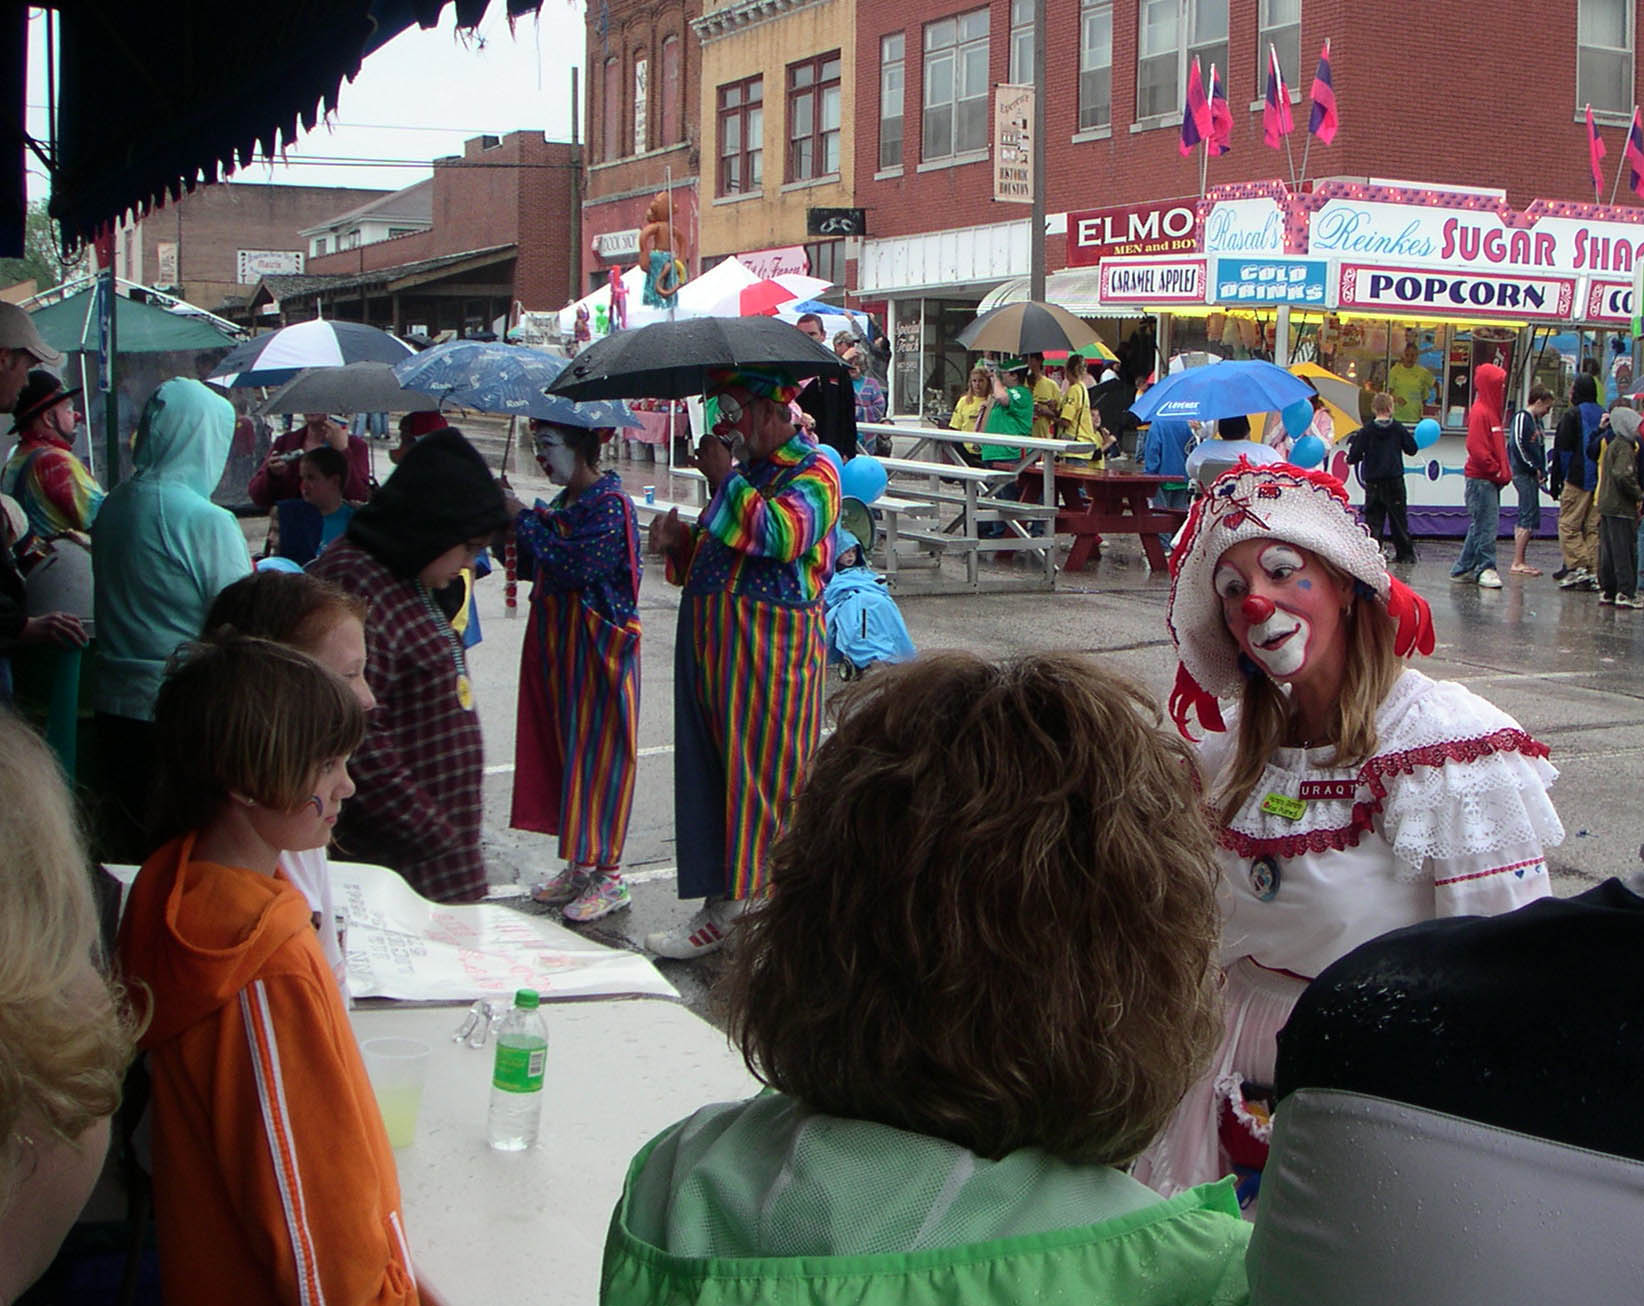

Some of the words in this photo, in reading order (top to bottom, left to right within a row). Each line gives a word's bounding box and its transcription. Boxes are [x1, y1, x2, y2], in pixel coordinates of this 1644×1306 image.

[1078, 207, 1194, 247] ELMO
[1207, 208, 1279, 252] Rascal's
[1313, 207, 1436, 257] Reinkes
[1441, 217, 1556, 267] SUGAR
[1114, 243, 1142, 255] MEN
[1145, 241, 1169, 252] and
[1111, 269, 1155, 293] CARAMEL
[1159, 268, 1196, 293] APPLES
[1241, 264, 1307, 283] COLD
[1219, 281, 1323, 300] DRINKS
[1369, 274, 1545, 309] POPCORN
